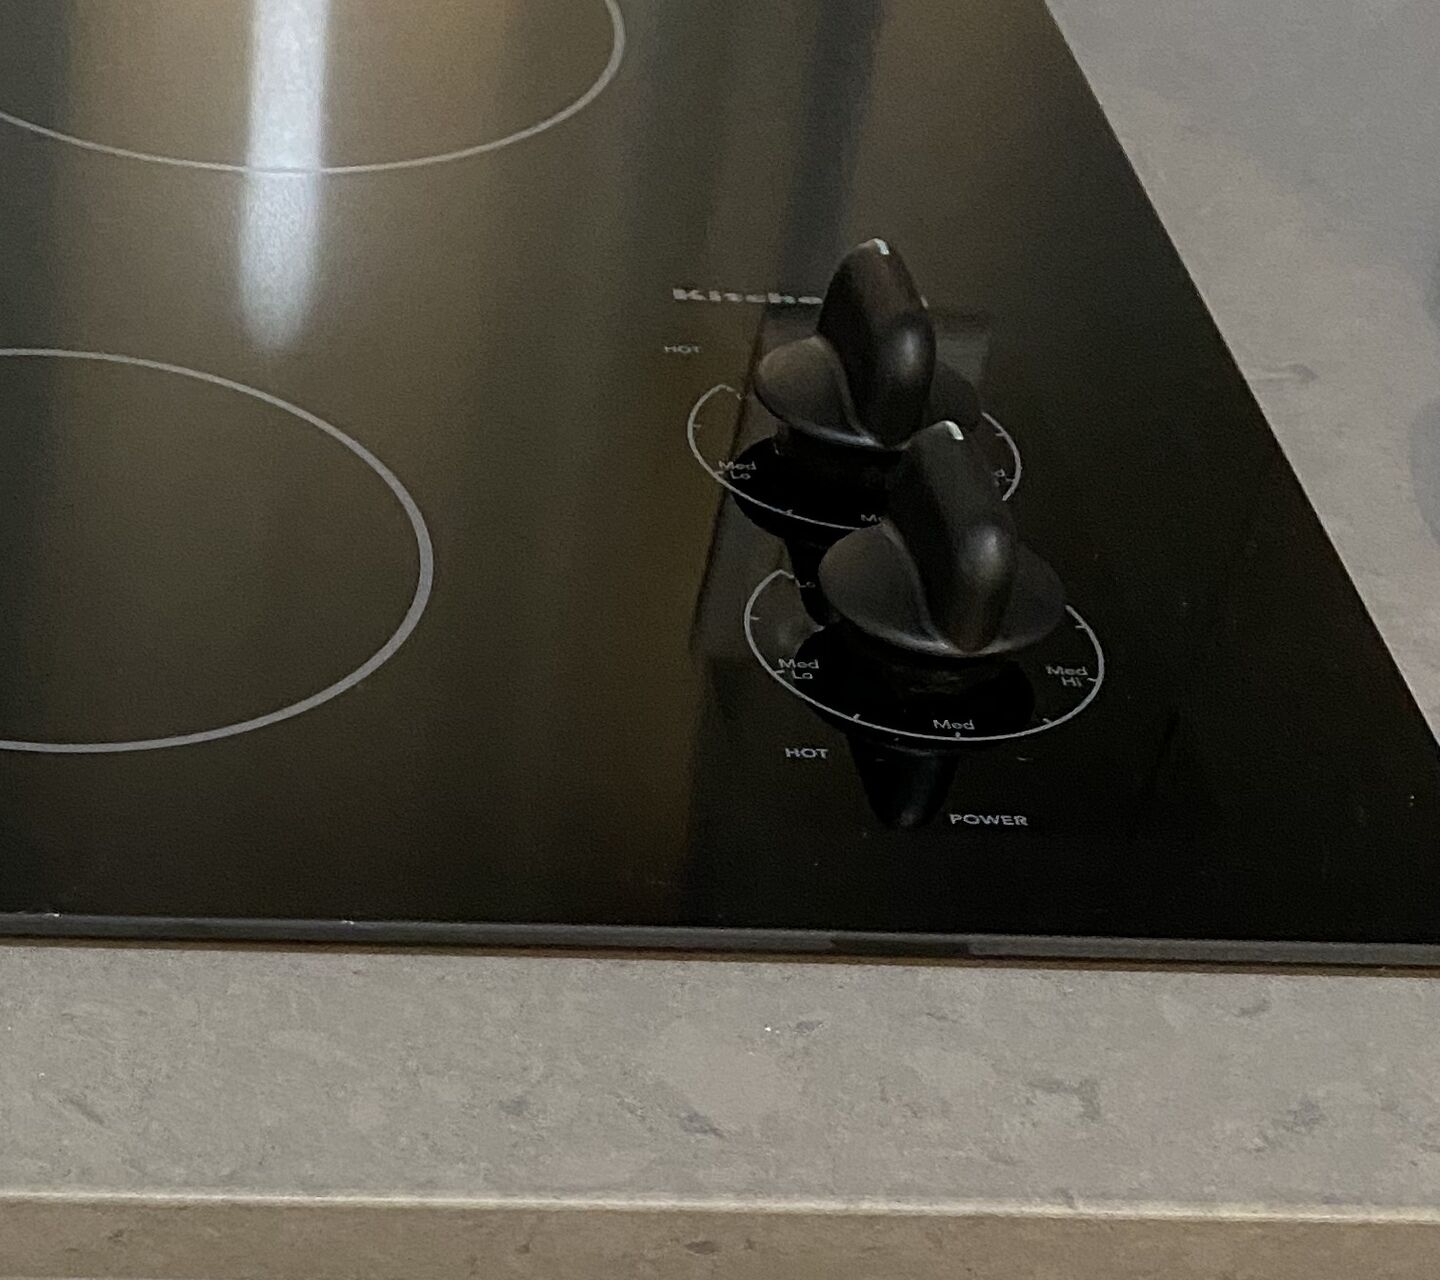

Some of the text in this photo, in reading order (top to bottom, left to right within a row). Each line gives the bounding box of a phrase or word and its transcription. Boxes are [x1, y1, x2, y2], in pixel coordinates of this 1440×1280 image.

[663, 344, 702, 354] HOT
[777, 657, 820, 669] Med
[791, 669, 814, 680] Lo
[1045, 665, 1089, 676] Med
[932, 718, 976, 731] Med
[784, 746, 830, 760] HOT
[948, 812, 1030, 828] POWER
